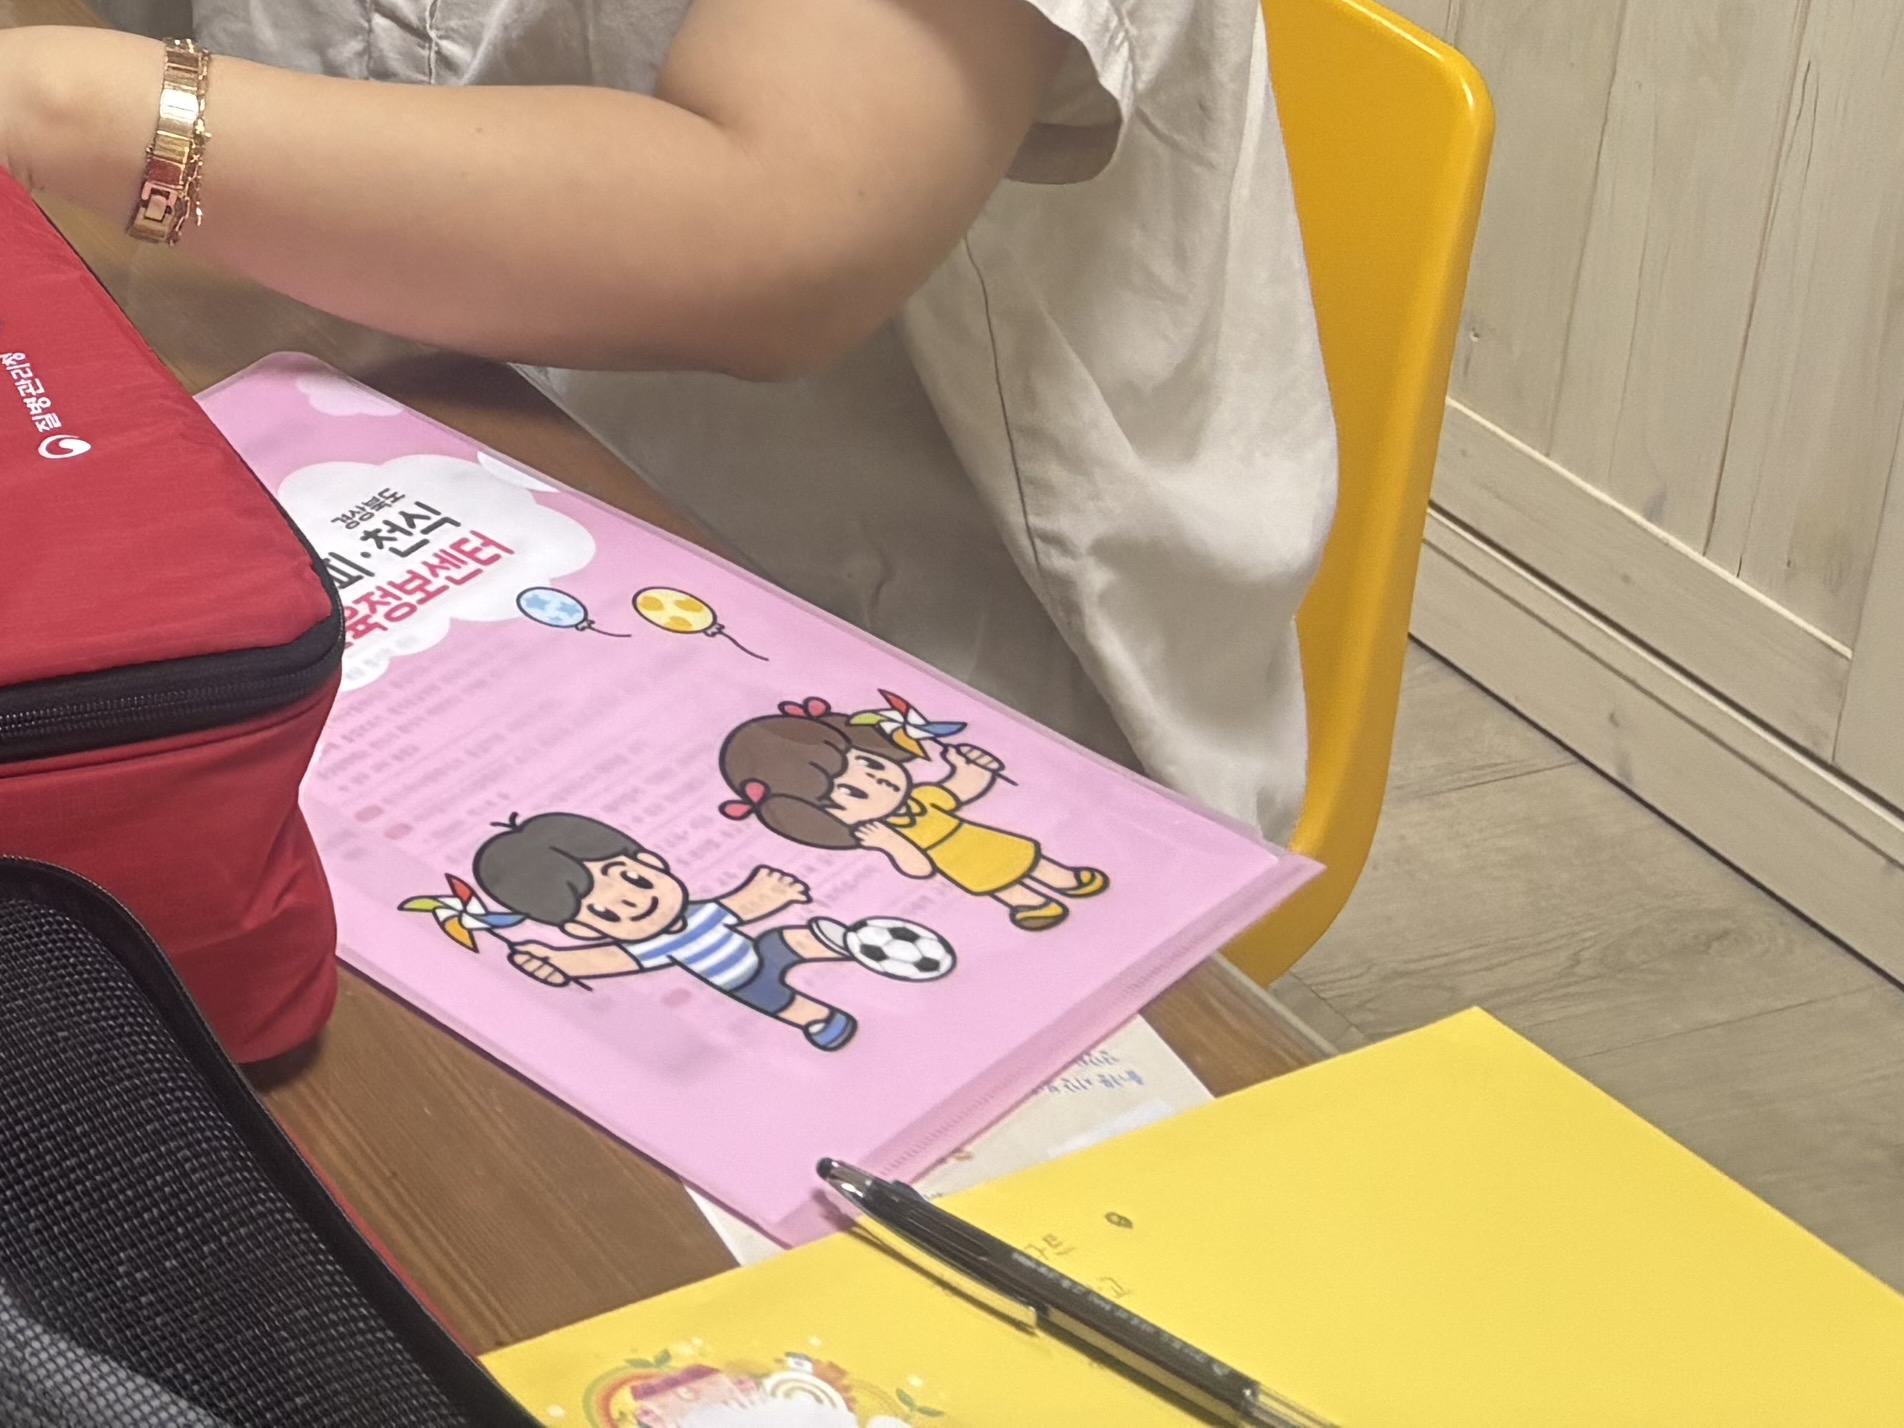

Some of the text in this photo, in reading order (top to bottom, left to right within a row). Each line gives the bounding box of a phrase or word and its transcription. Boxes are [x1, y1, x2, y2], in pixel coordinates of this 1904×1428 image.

[2, 349, 63, 434] 질병관리청
[327, 501, 461, 596] 피·천식
[331, 487, 406, 531] 경상북도
